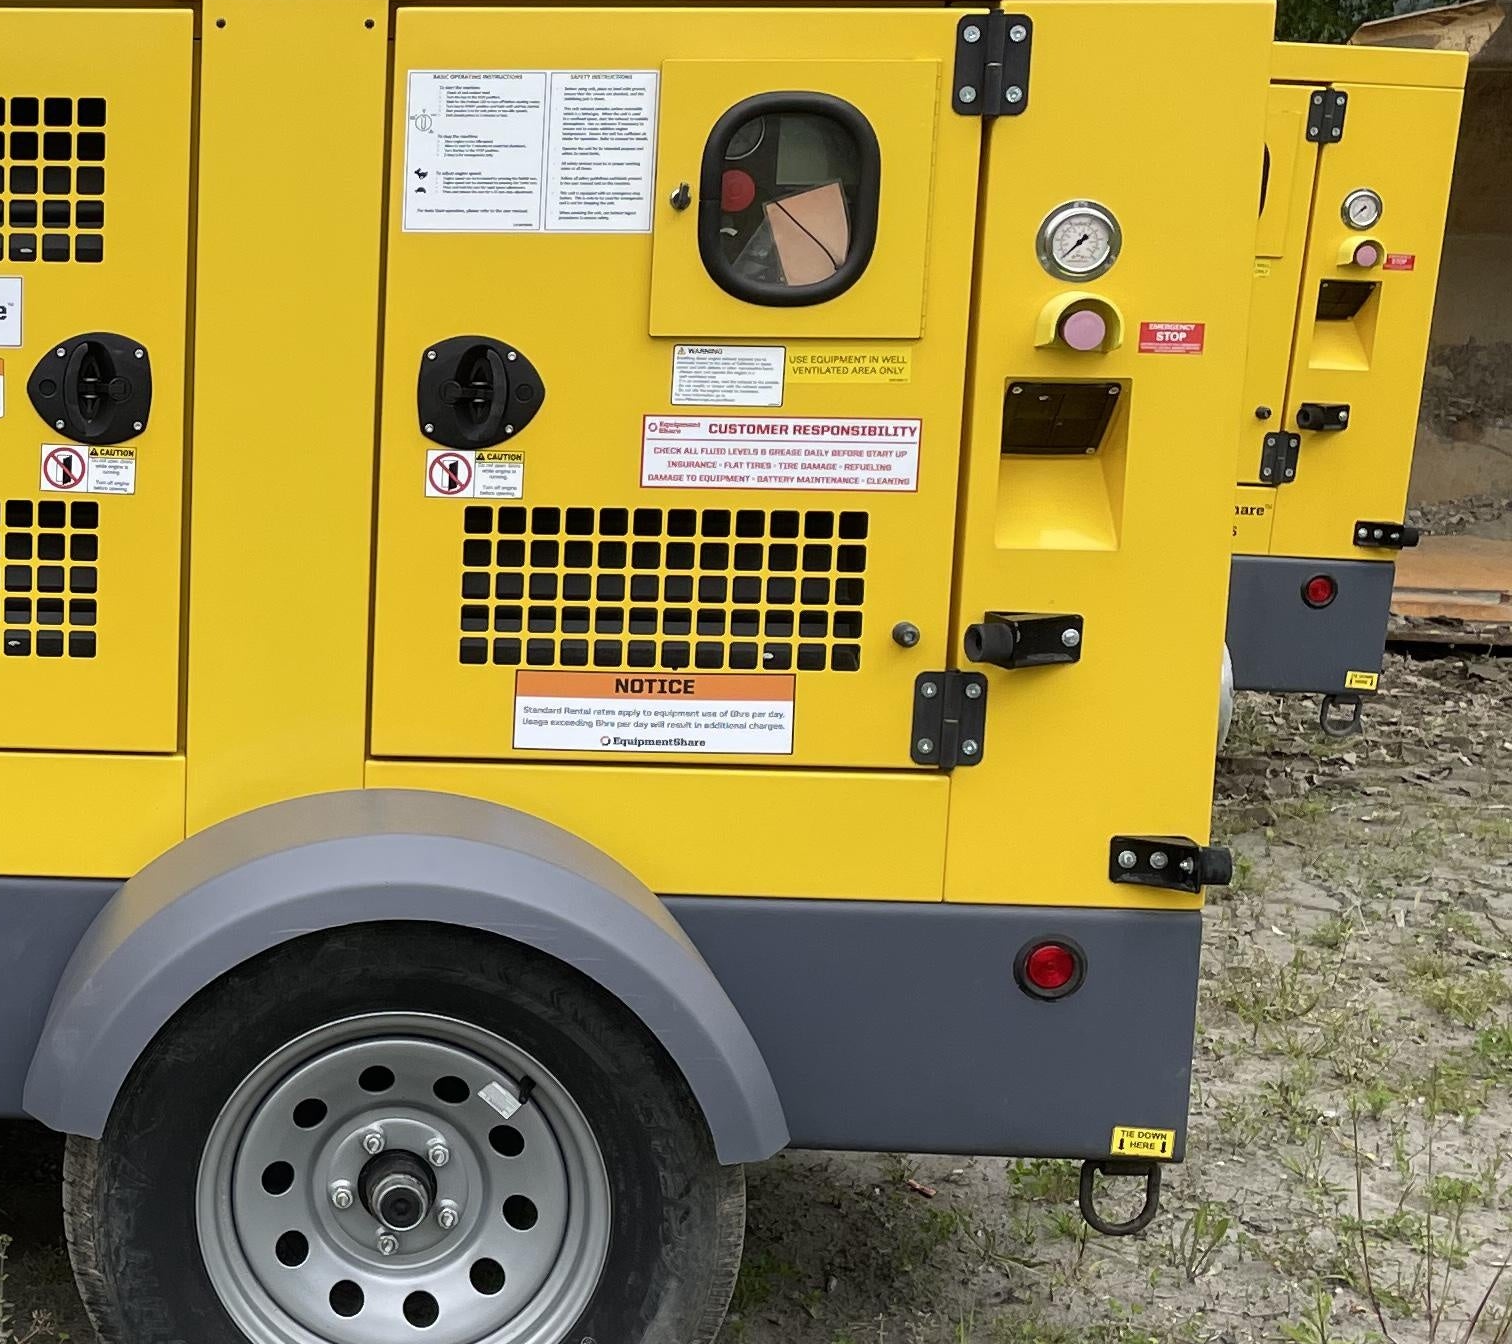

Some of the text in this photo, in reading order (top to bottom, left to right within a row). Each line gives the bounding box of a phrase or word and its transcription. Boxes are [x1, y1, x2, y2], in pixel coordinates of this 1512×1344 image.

[1156, 331, 1187, 342] STOP
[789, 355, 907, 364] USE EQUIPMENT IN WELL
[792, 366, 904, 375] VENTILATED AREA ONLY
[708, 423, 917, 437] CUSTOMER RESPONSIBILITY
[99, 448, 135, 457] CAUTION
[486, 453, 522, 461] CAUTION
[653, 446, 682, 455] CHECK
[683, 447, 699, 455] ALL
[700, 447, 726, 456] FLUID
[728, 447, 759, 456] LEVELS
[768, 448, 803, 457] GREASE
[804, 449, 829, 457] DAILY
[831, 449, 865, 458] BEFORE
[866, 450, 893, 458] START
[895, 450, 908, 459] UP
[667, 460, 892, 471] INSURANCE FLAT TIRES TIRE DAMAGE REFUELING
[647, 473, 910, 486] DAMAGE TO EQUIPMENT BATTERY MAINTENANCE CLEANING
[614, 677, 695, 695] NOTICE
[523, 705, 562, 714] Standard
[564, 706, 592, 715] Rental
[593, 708, 616, 716] rates
[617, 708, 641, 718] apply
[653, 709, 700, 718] equipment
[719, 709, 729, 717] of
[751, 711, 767, 719] per
[522, 717, 549, 727] Usage
[550, 718, 593, 728] exceeding
[616, 720, 631, 729] per
[633, 720, 648, 729] day
[666, 721, 692, 729] result
[694, 721, 703, 729] in
[704, 721, 746, 730] additional
[612, 736, 706, 747] EquipmentShare
[1120, 1130, 1168, 1141] TIE DOWN
[1129, 1141, 1156, 1150] HERE
